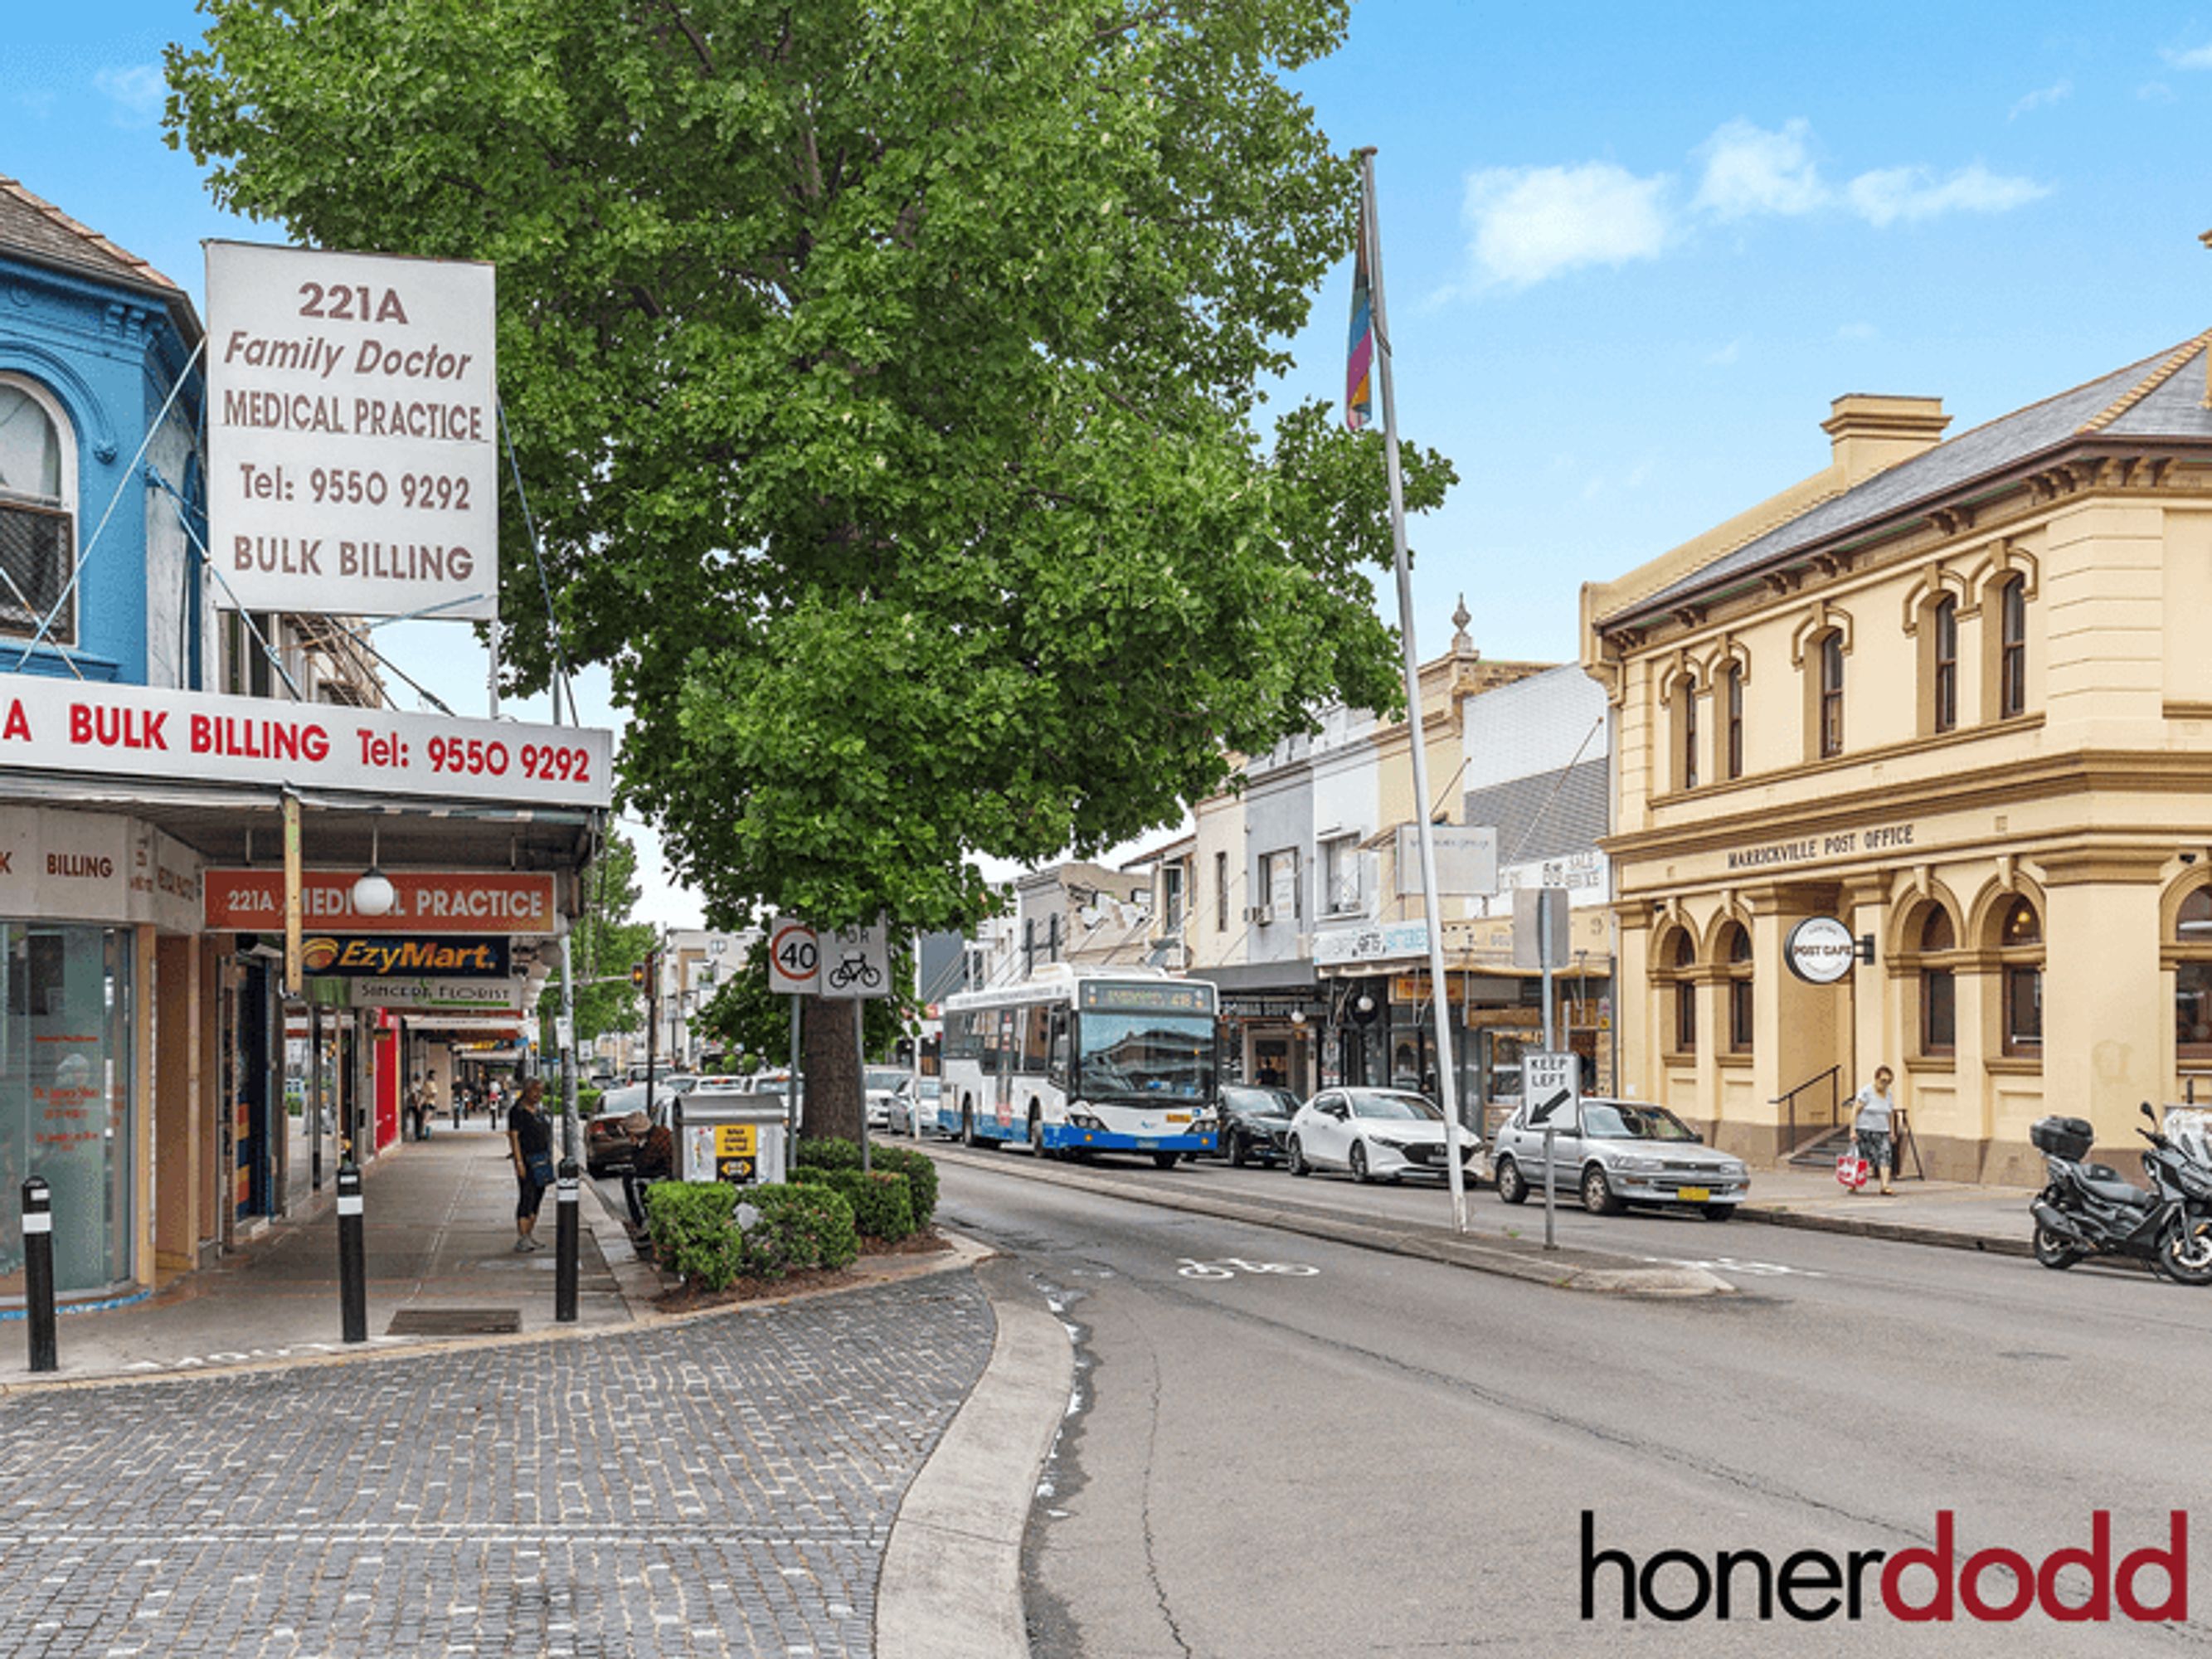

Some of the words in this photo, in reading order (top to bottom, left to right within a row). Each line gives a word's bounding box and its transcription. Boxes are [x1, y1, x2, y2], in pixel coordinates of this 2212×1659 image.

[299, 282, 408, 324] 221A
[224, 331, 344, 378] Family
[355, 339, 471, 380] Doctor
[224, 390, 344, 432] MEDICAL
[354, 398, 481, 440] PRACTICE
[241, 464, 294, 501] Tel:
[310, 469, 387, 505] 9550
[401, 474, 470, 510] 9292
[234, 536, 322, 576] BULK
[339, 542, 474, 581] BILLING
[2, 698, 32, 742] A
[69, 703, 168, 751] BULK
[191, 715, 329, 761] BILLING
[358, 730, 409, 768] Tel:
[427, 737, 508, 776] 9550
[521, 744, 590, 782] 9292
[46, 853, 114, 878] BILLING
[1728, 839, 1817, 868] MARRICKVILLE
[1825, 832, 1856, 855] POST
[1864, 825, 1914, 849] OFFICE
[228, 890, 275, 911] 221A
[277, 888, 406, 916] EDIL
[417, 888, 542, 917] PRACTICE
[780, 942, 817, 969] 40
[1530, 1058, 1568, 1071] KEEP
[1532, 1073, 1566, 1087] LEFT
